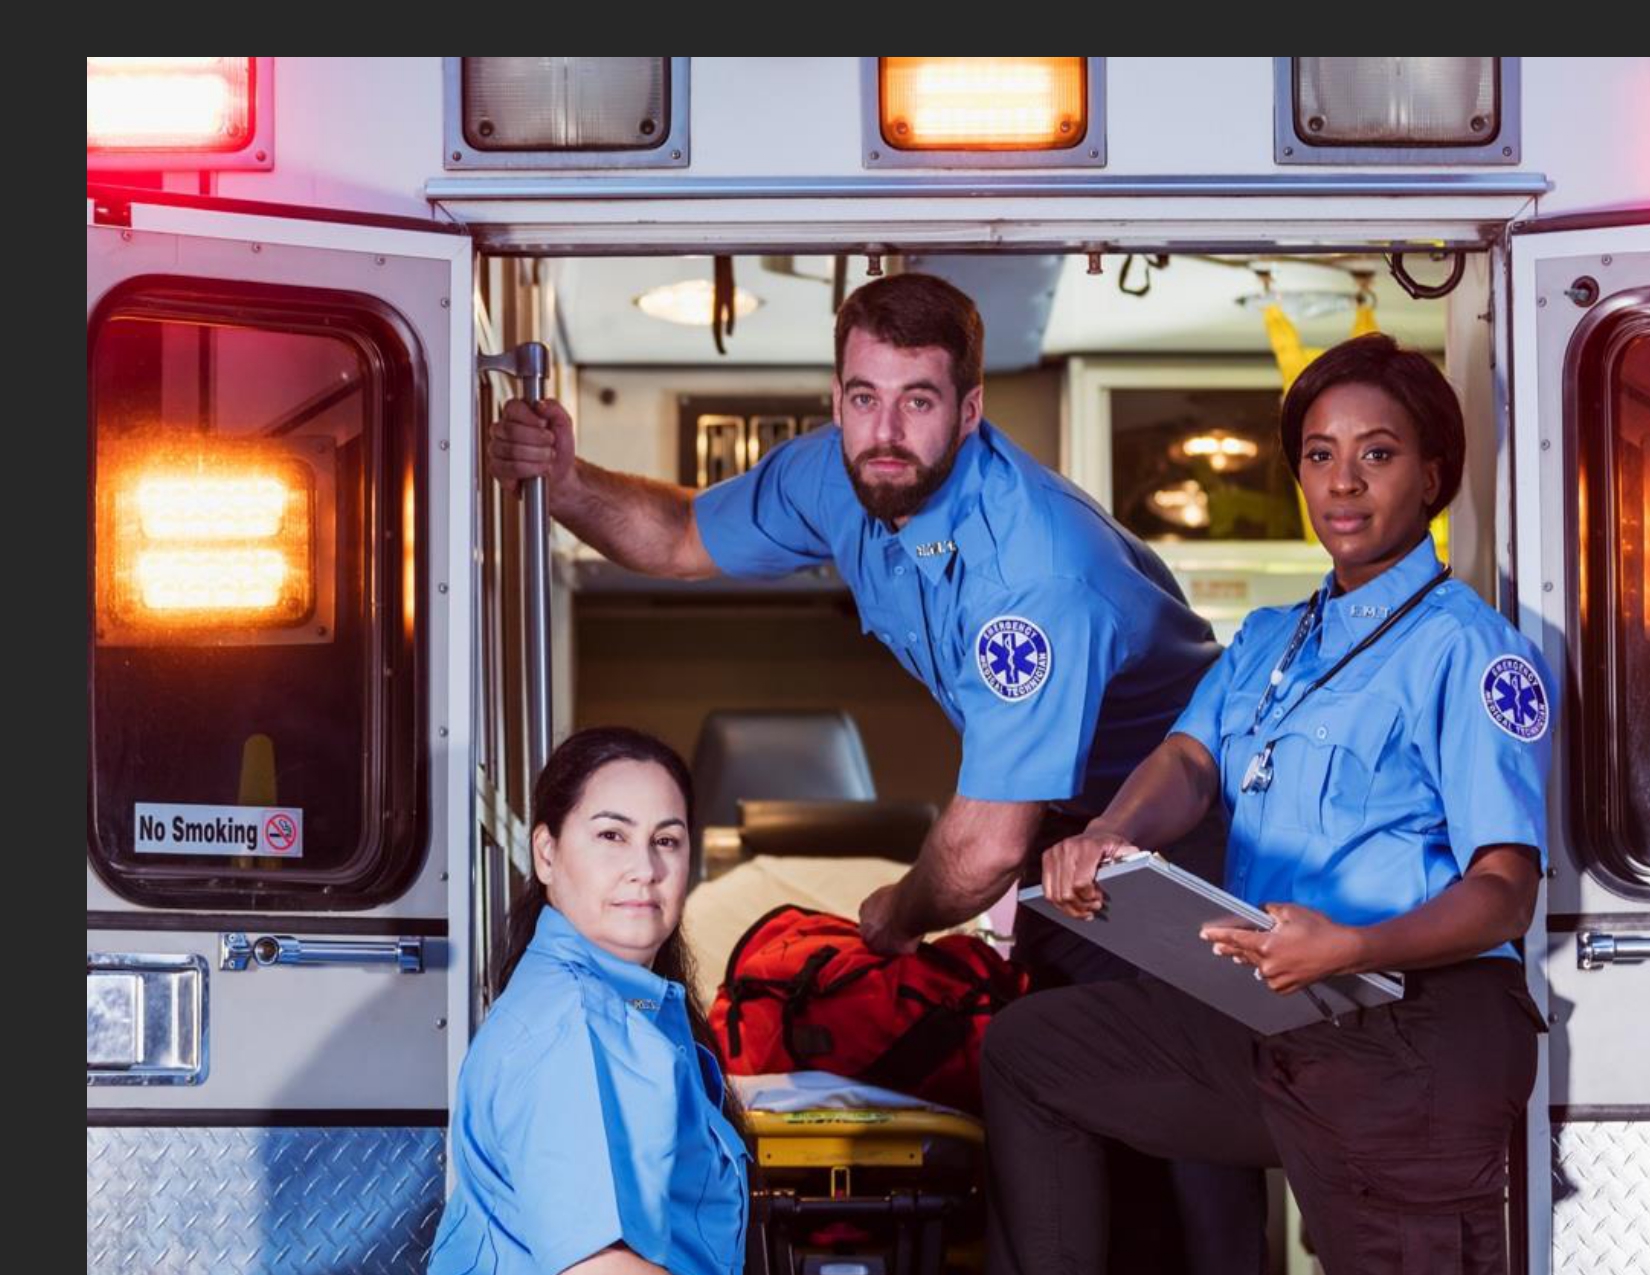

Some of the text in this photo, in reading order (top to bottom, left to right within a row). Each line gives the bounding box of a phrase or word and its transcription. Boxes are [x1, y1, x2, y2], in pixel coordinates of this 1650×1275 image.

[983, 621, 1037, 640] EMERGENCY
[980, 652, 1047, 696] MEDICAL TECHNICIAN
[1491, 660, 1539, 686] EMERGENCY
[139, 815, 259, 851] No Smoking
